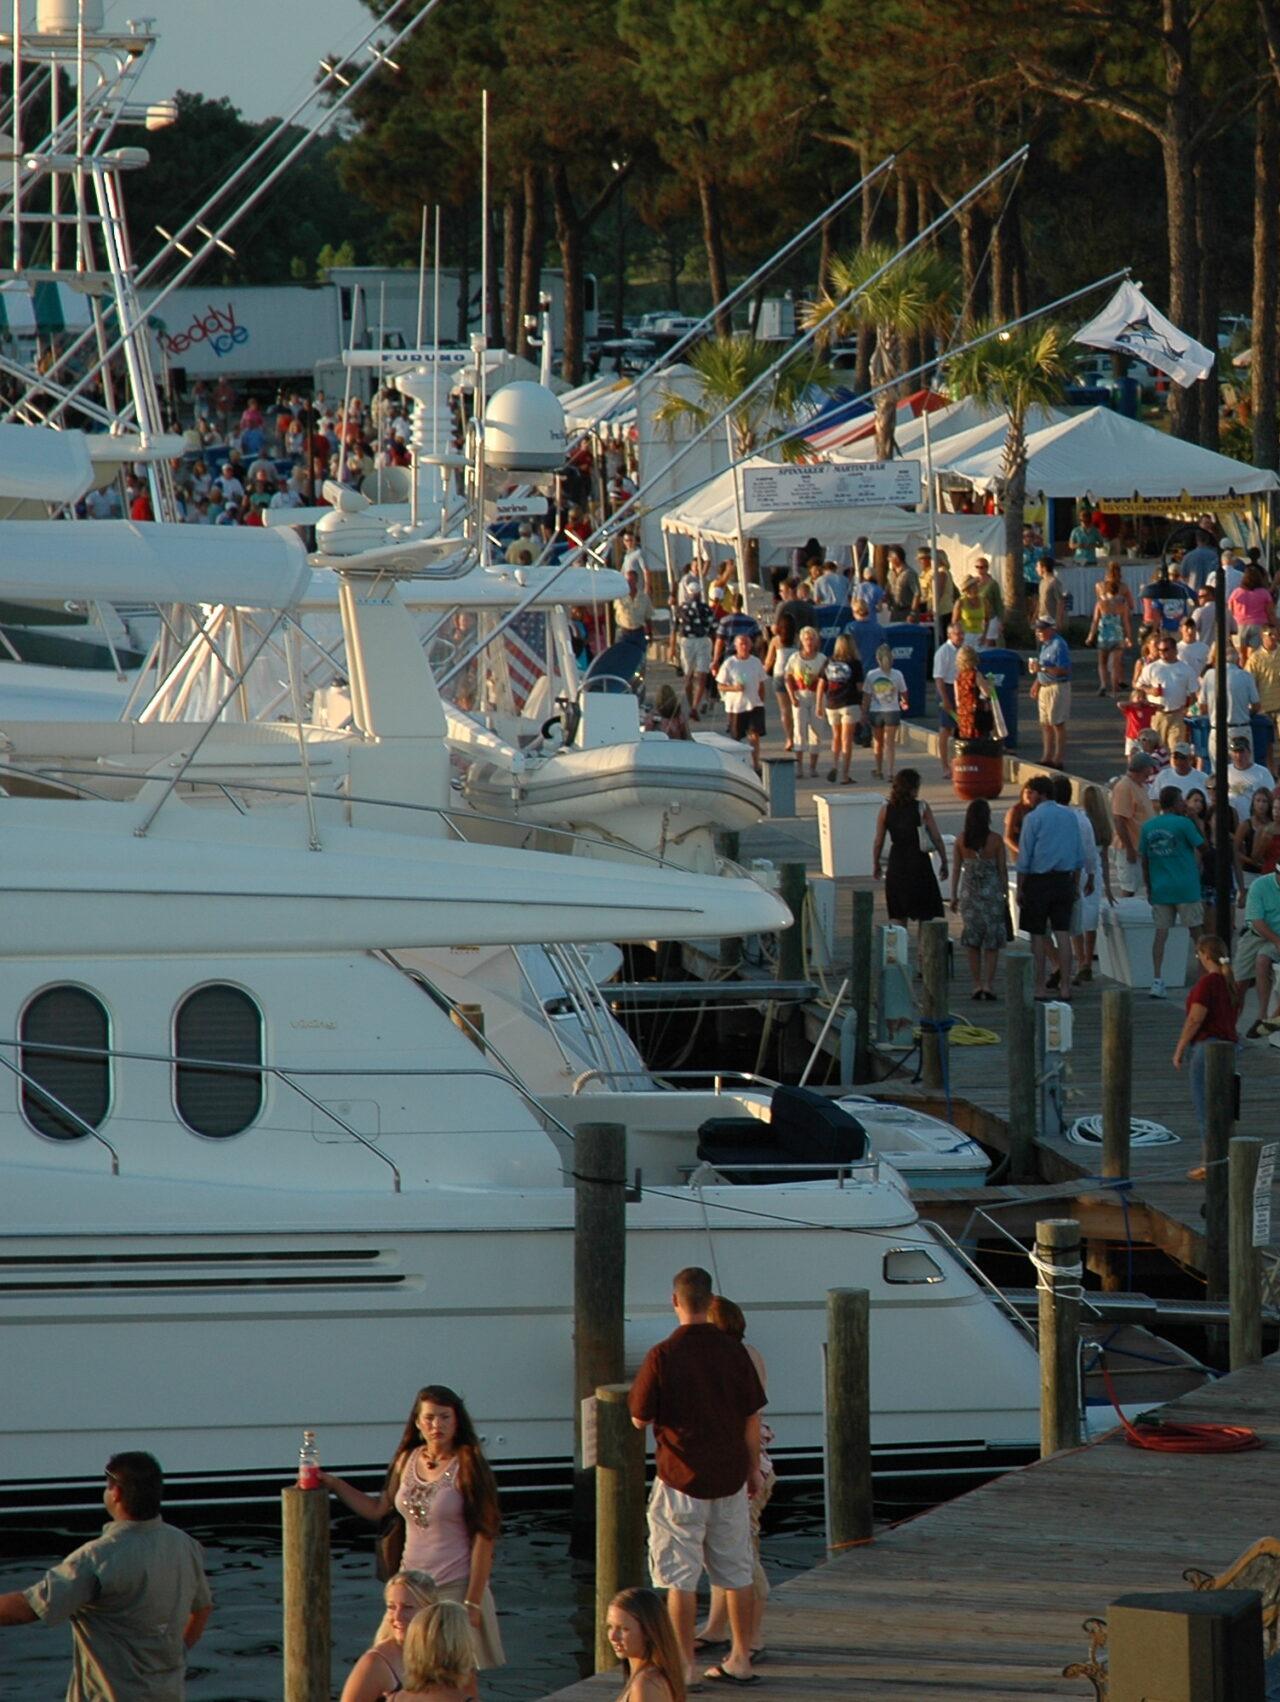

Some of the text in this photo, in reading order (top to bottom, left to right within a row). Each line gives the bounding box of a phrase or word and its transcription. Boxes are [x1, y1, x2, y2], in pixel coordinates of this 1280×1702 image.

[156, 303, 236, 360] Reddy
[208, 325, 249, 357] Ice
[382, 354, 465, 362] FURUNO
[497, 503, 527, 513] arine
